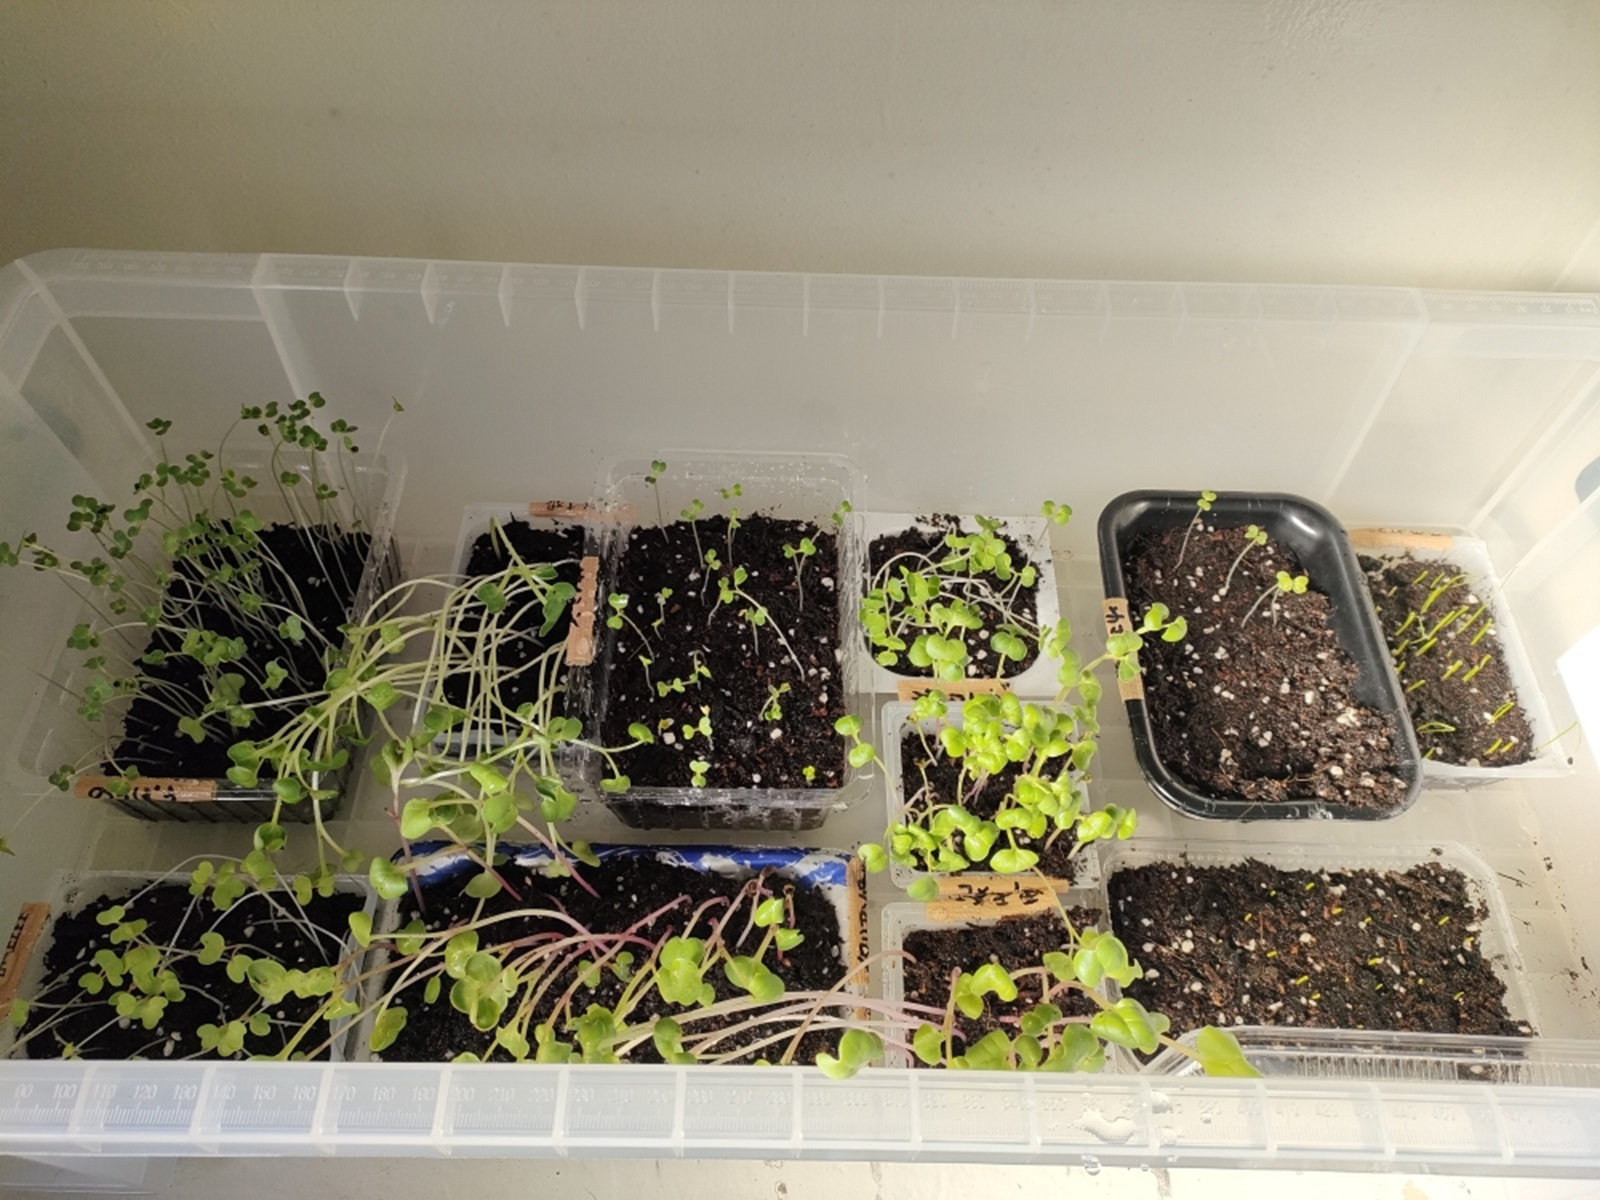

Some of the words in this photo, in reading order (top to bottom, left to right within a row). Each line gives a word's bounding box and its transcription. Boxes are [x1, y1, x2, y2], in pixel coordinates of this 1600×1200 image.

[52, 1083, 77, 1099] 100
[93, 1083, 118, 1099] 110
[134, 1084, 158, 1099] 120
